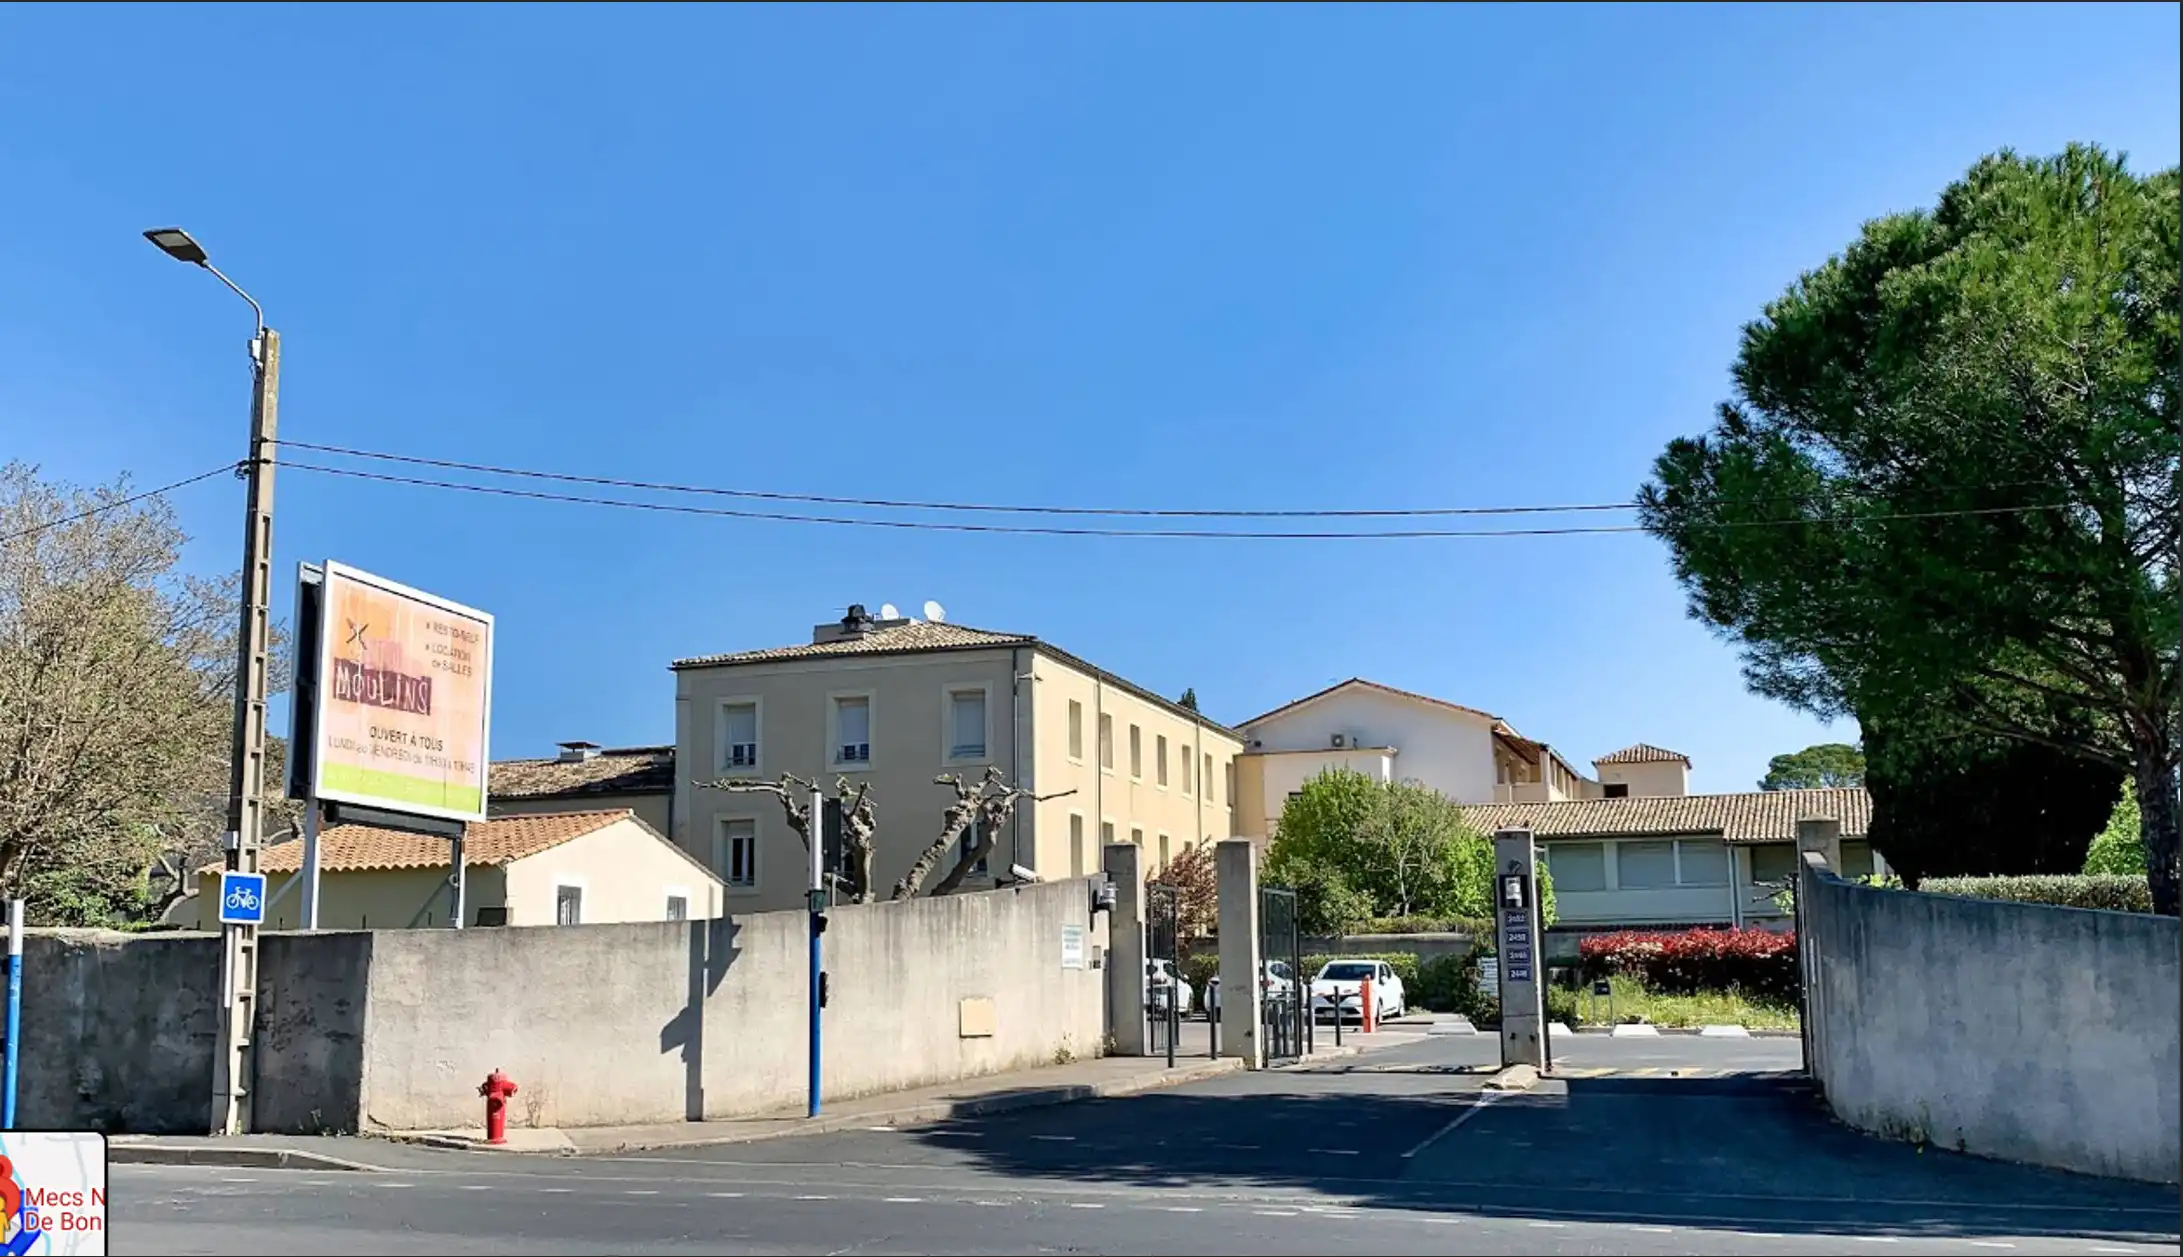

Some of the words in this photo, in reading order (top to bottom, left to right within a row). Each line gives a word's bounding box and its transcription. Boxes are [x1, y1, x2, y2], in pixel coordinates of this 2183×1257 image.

[335, 664, 430, 715] MOULINS
[369, 725, 408, 745] OUVERT
[419, 736, 443, 752] TOUS
